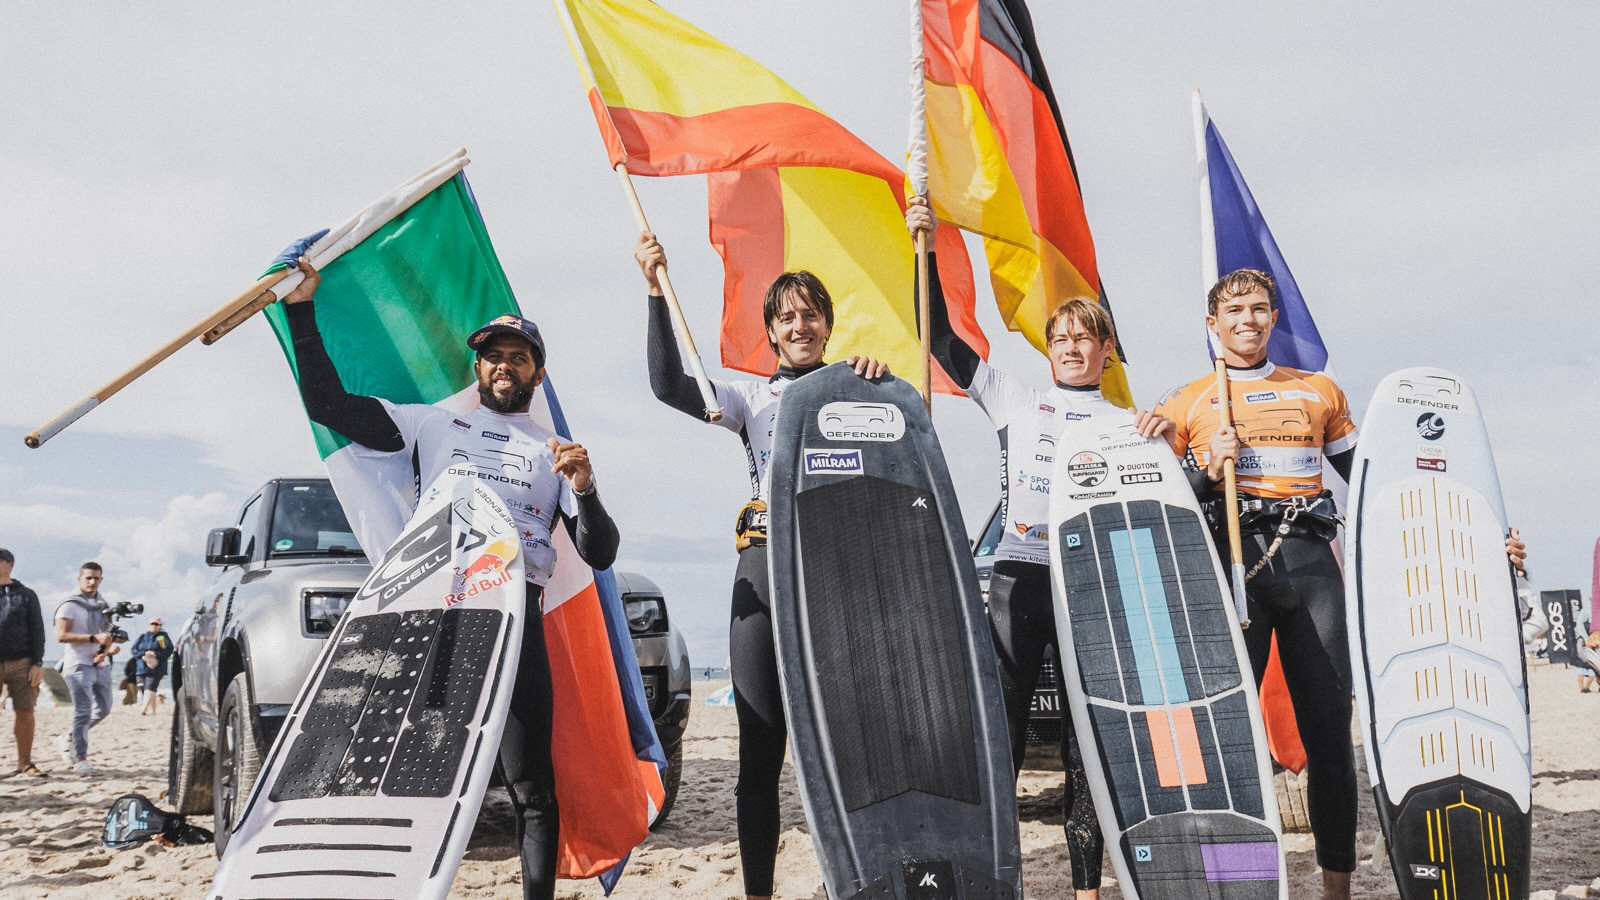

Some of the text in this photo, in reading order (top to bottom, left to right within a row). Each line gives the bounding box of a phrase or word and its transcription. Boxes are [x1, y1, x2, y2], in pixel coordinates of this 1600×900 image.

[1397, 397, 1459, 411] DEFENDER
[483, 431, 508, 442] MILRAM
[826, 431, 895, 439] DEFENDER
[1240, 435, 1314, 443] EFENDER
[1101, 440, 1150, 452] DEFENDER
[811, 457, 857, 469] MILRAM
[1239, 455, 1263, 464] ORT
[1291, 457, 1304, 465] SH
[1073, 462, 1103, 470] KARMA
[1127, 462, 1160, 471] DUOTONE
[1234, 462, 1276, 470] AND.SH
[448, 468, 532, 490] DEFENDER
[1072, 470, 1105, 478] SURFBOARDS
[1030, 475, 1050, 486] SPO
[1029, 483, 1050, 494] LAN
[475, 487, 517, 529] DEFENDER
[507, 498, 522, 508] SH
[1029, 530, 1049, 540] AID
[383, 553, 448, 600] O'NEILL
[444, 569, 513, 607] Red Bull
